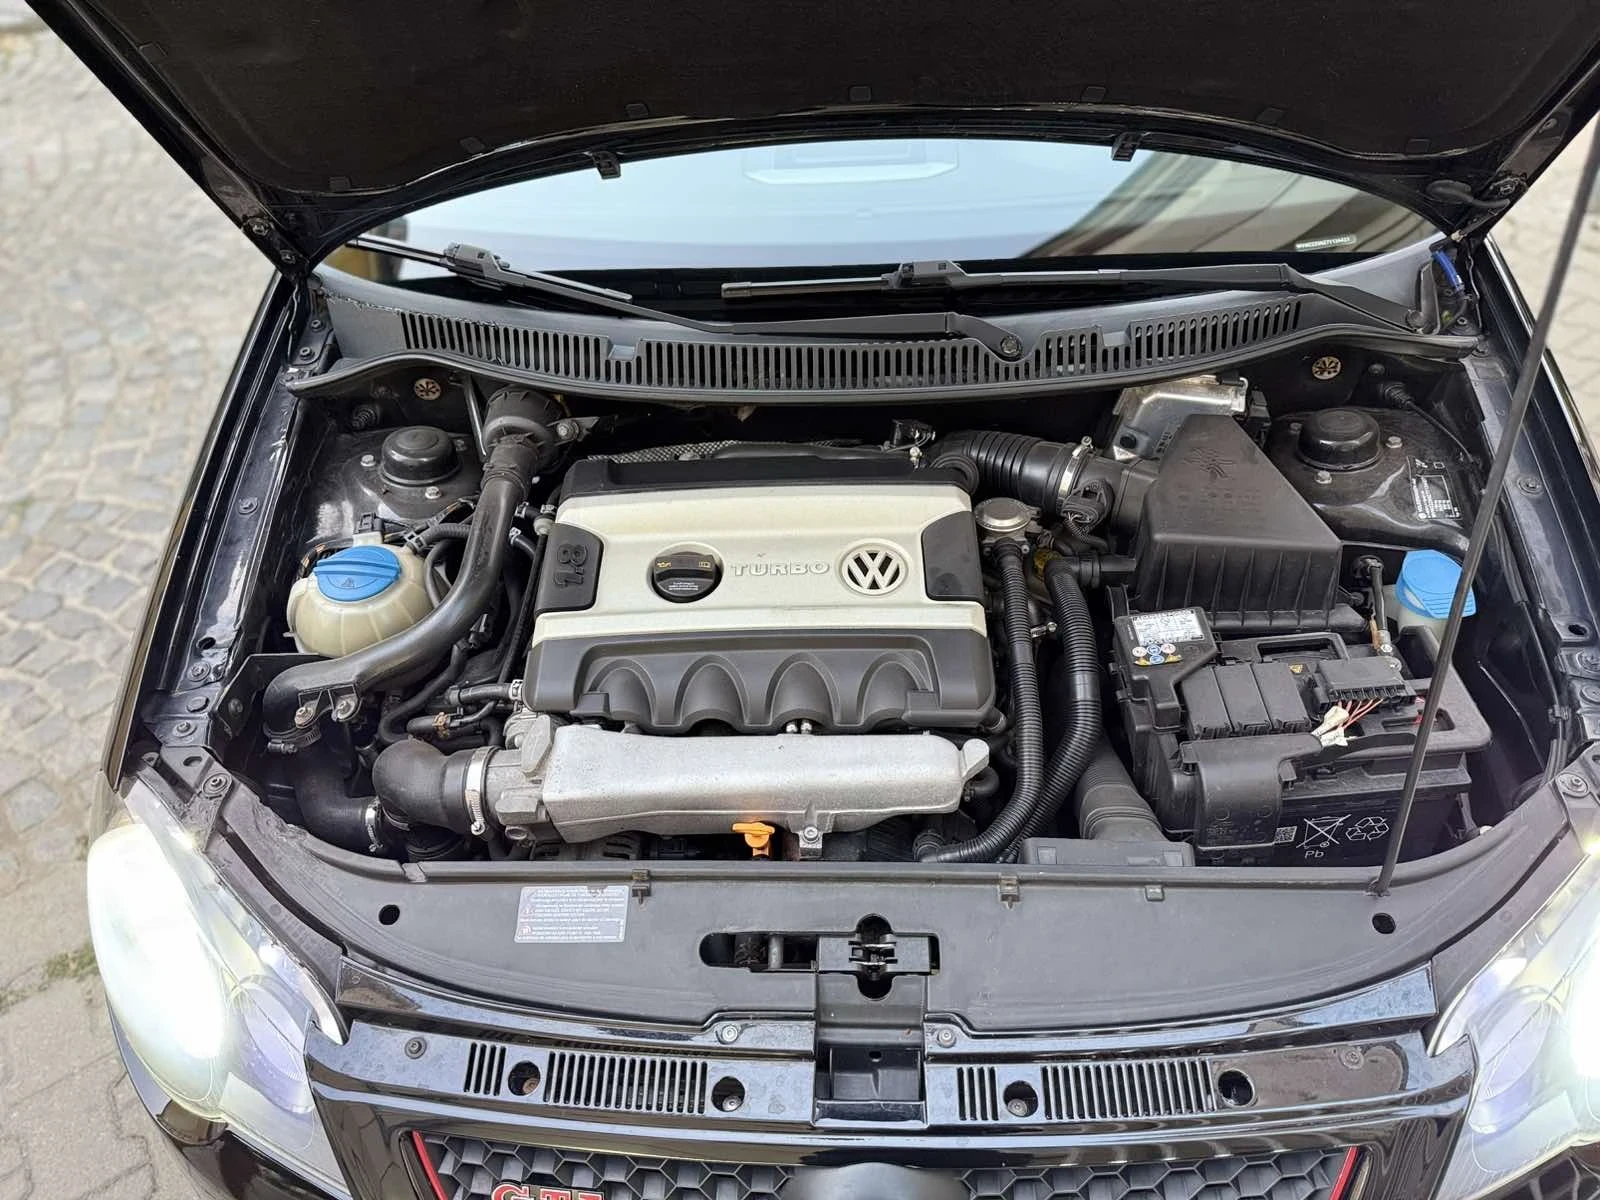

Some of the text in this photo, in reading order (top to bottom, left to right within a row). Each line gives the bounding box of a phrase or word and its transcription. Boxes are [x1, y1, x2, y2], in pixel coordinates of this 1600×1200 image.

[554, 544, 588, 587] 1.8
[731, 561, 830, 577] TURBO
[844, 548, 905, 593] VW
[1304, 850, 1324, 858] Pb
